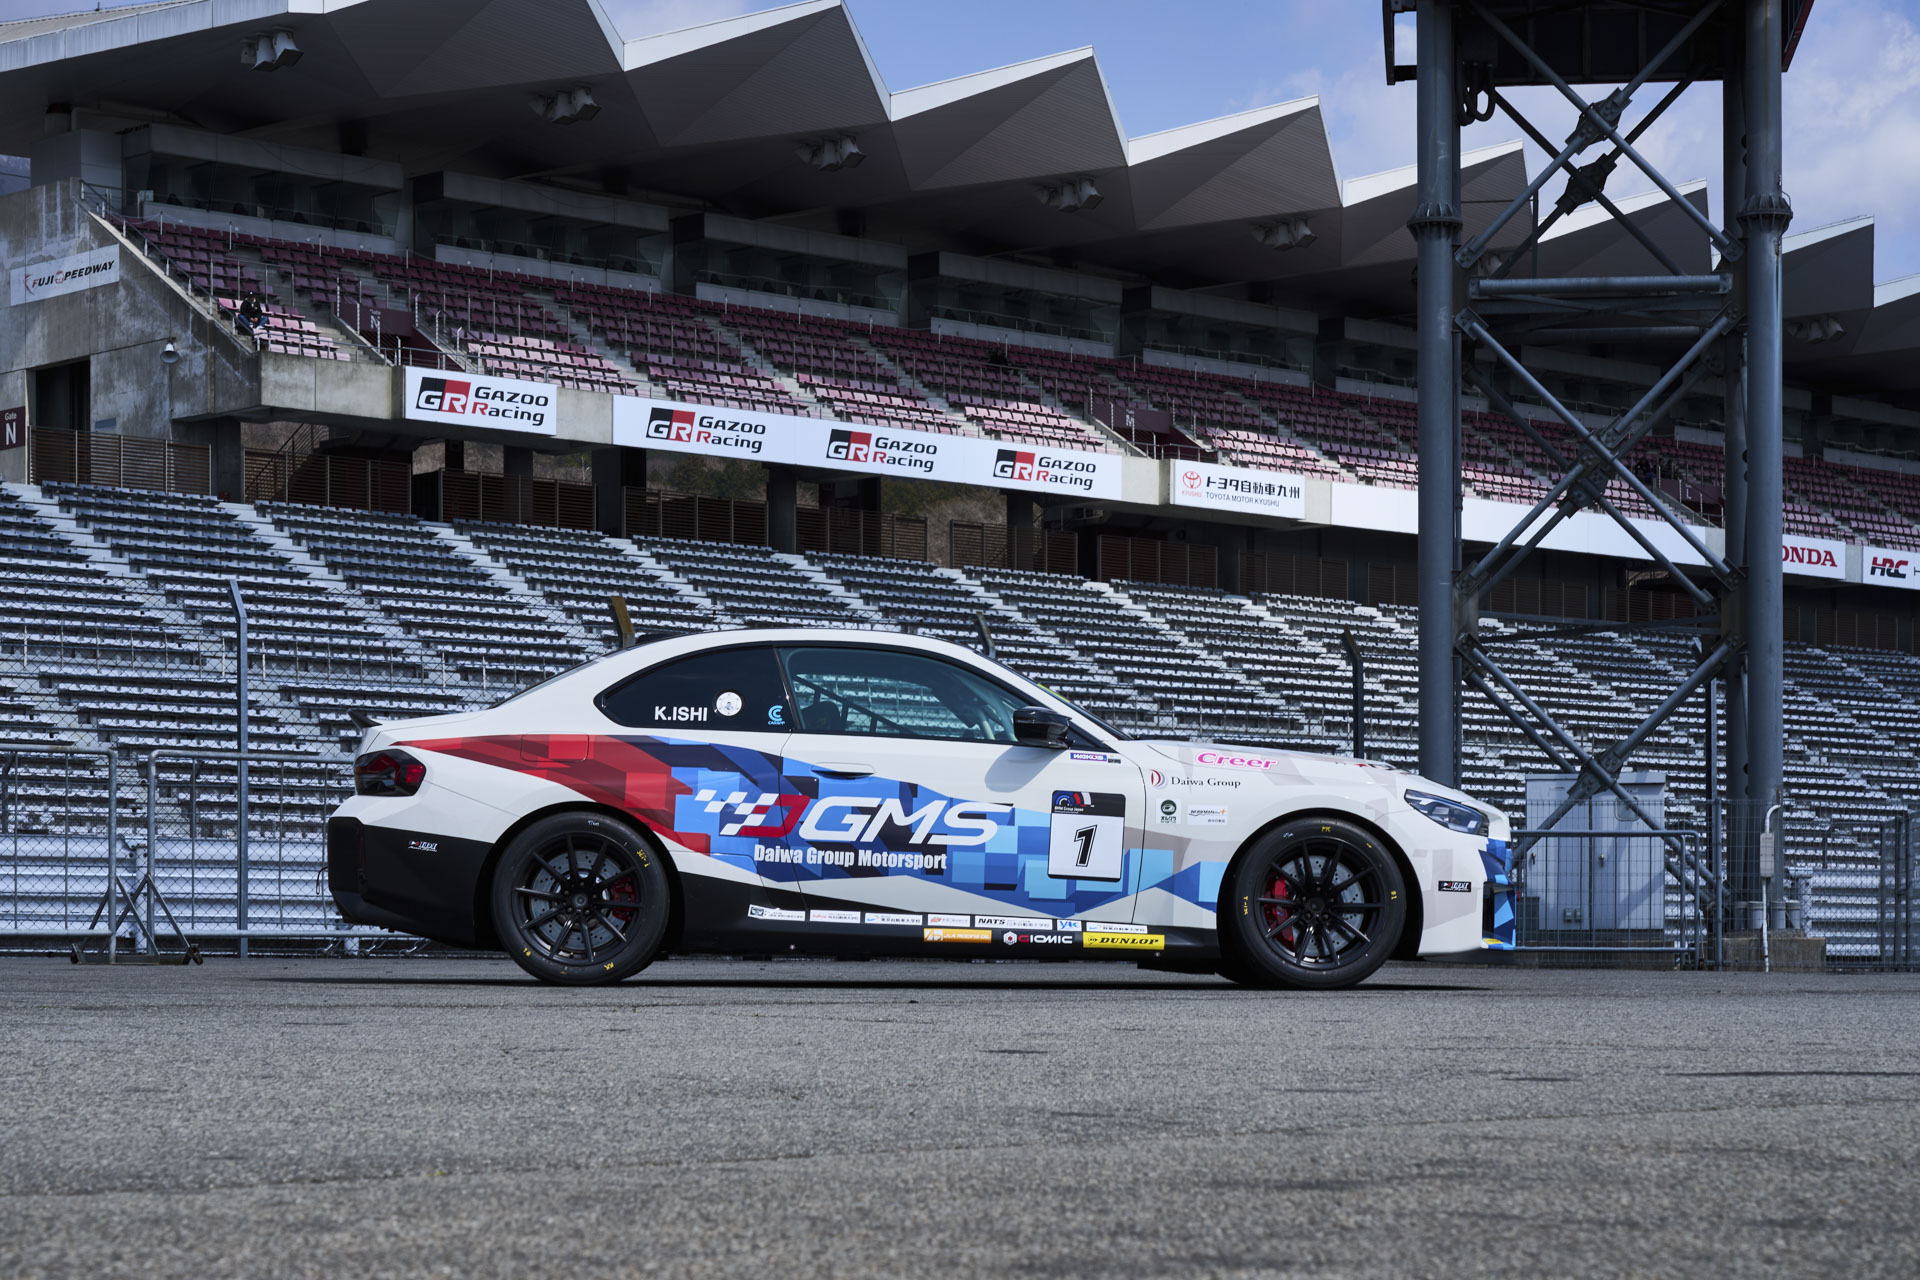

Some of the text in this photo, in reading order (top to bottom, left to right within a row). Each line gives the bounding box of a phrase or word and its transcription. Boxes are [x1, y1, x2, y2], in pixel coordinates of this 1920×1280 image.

[31, 275, 54, 288] FUJI
[474, 386, 549, 407] GAZOO
[4, 412, 17, 421] Gate
[471, 401, 545, 426] Racing
[5, 421, 17, 446] N
[698, 416, 766, 435] GAZOO
[696, 430, 763, 453] Racing
[875, 437, 938, 455] GAZOO
[872, 451, 935, 473] Racing
[1038, 456, 1097, 473] GAZOO
[1036, 470, 1094, 491] Racing
[1206, 476, 1300, 499] トヨタ自動車九州
[1206, 492, 1280, 507] TOYOTA MOTOR KYUSHU
[654, 706, 708, 721] K.ISHI
[1198, 752, 1278, 769] Creer
[1171, 776, 1241, 789] Daiwa Group
[1074, 824, 1098, 867] 1
[754, 844, 947, 870] Daiwa Group Motorsport
[1100, 937, 1159, 945] DUNLOP
